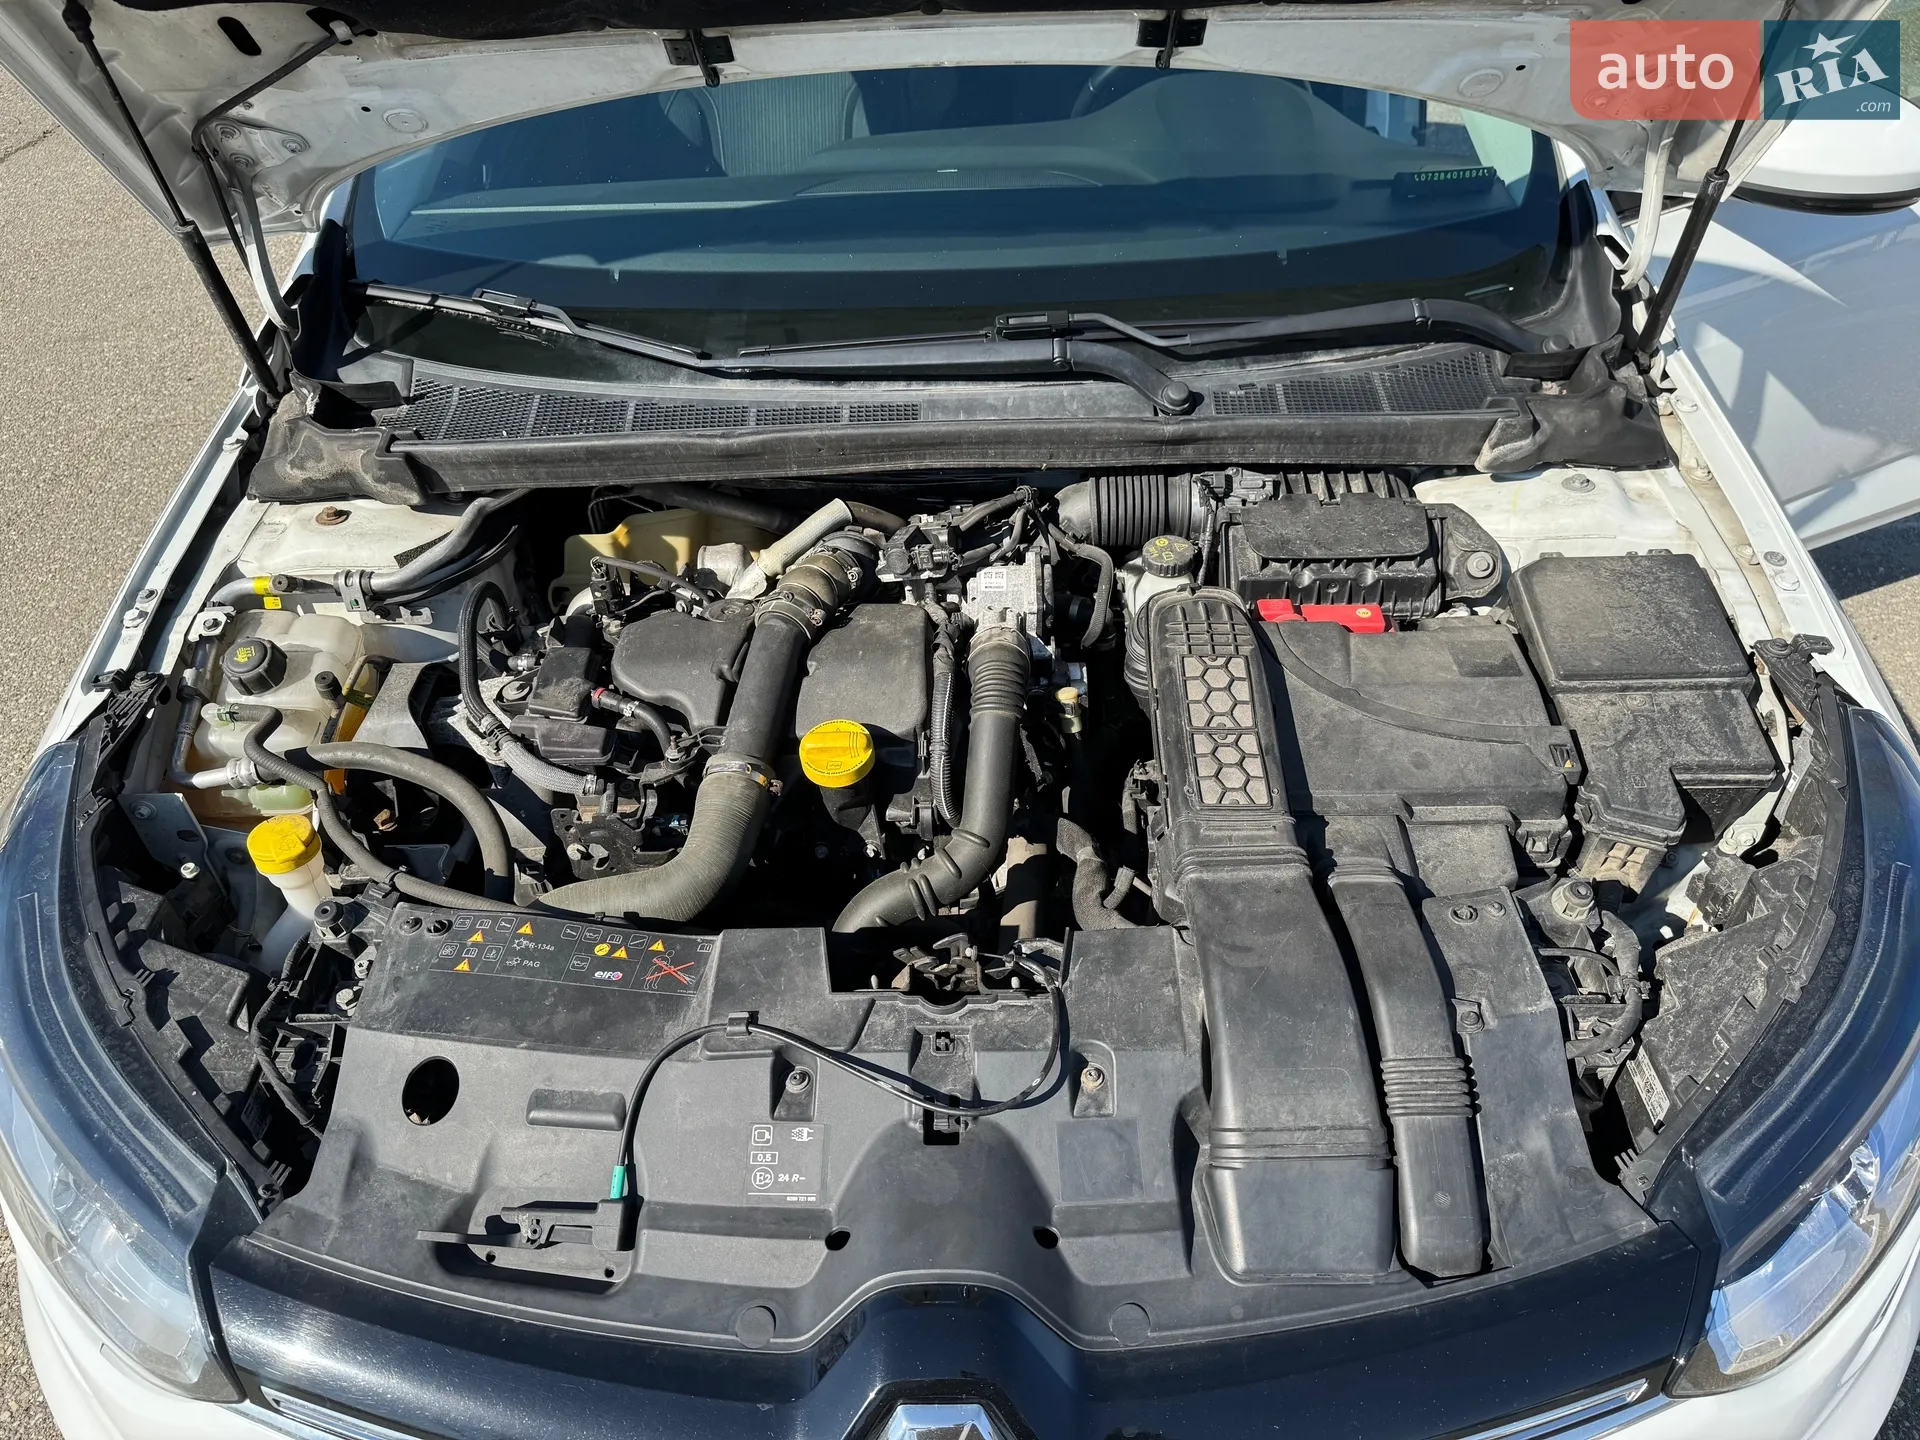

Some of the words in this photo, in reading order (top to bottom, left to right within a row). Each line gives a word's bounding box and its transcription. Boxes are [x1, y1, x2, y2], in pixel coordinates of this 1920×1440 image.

[528, 942, 555, 951] R-134a
[522, 959, 541, 968] PAG
[757, 1154, 771, 1163] 0,5
[778, 1174, 789, 1182] 24
